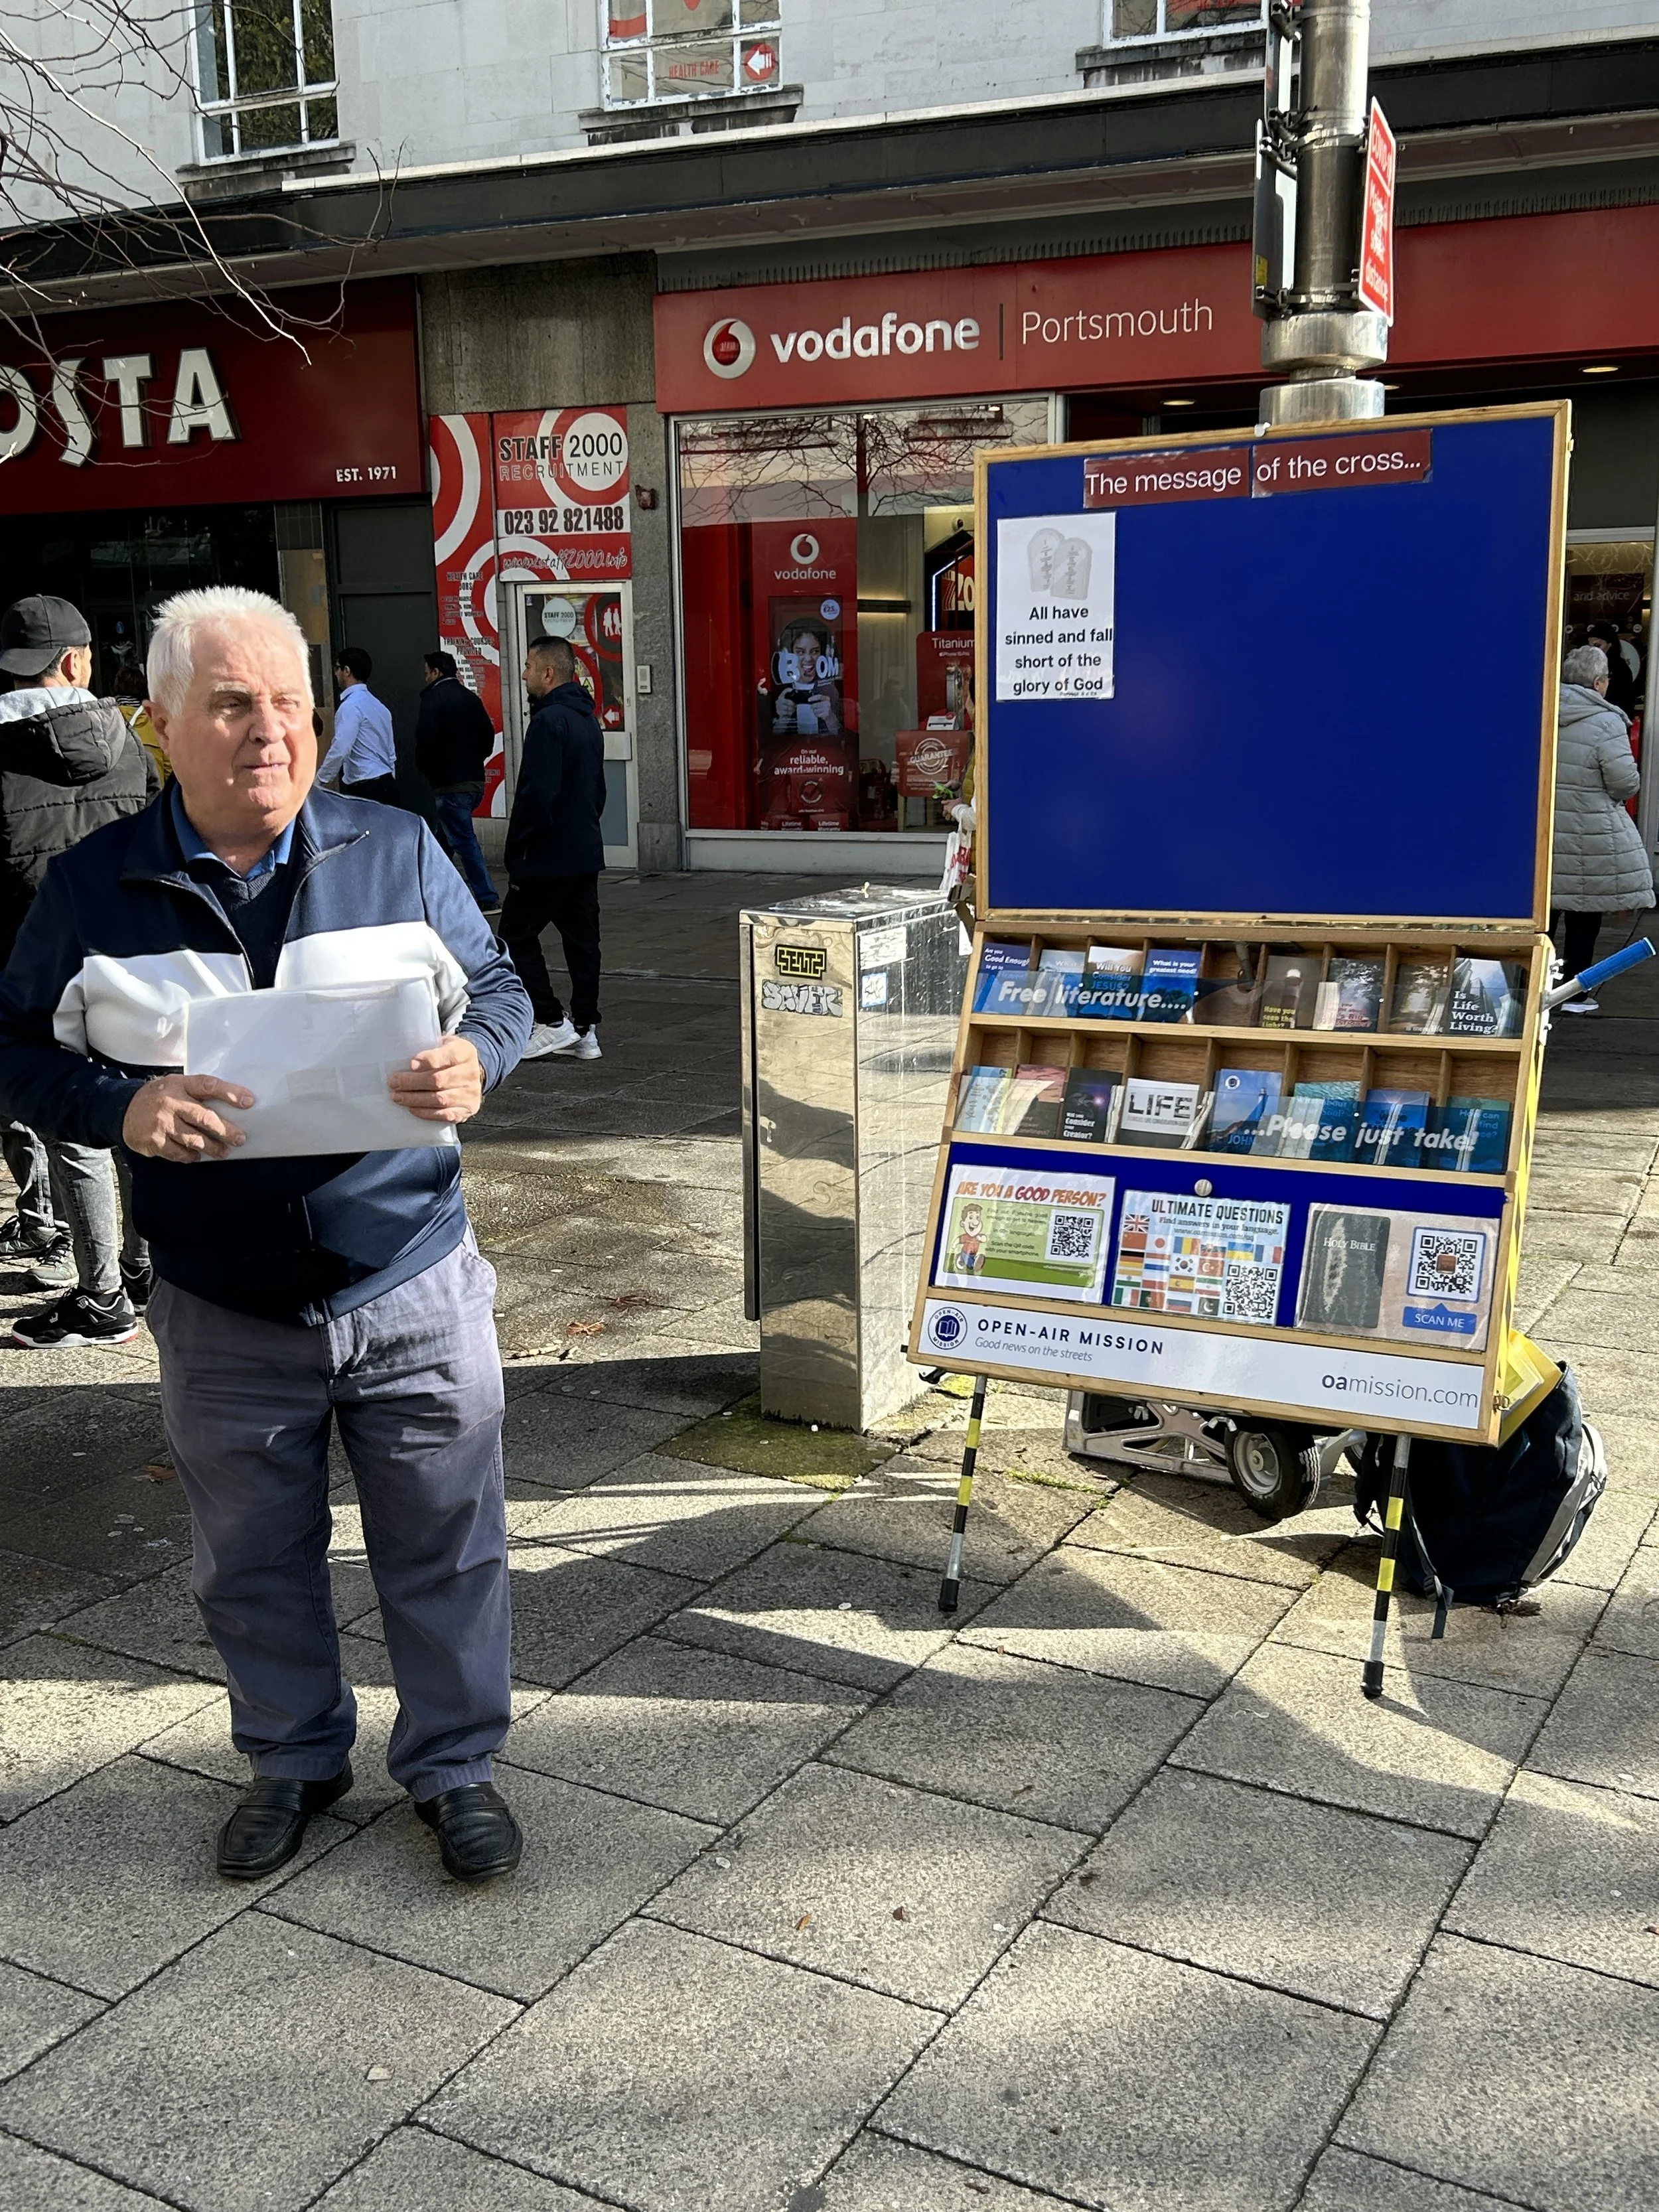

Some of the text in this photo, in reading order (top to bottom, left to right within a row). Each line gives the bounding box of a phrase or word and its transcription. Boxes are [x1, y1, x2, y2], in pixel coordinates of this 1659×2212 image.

[1023, 298, 1212, 344] Portsmouth
[770, 312, 980, 363] vodafone
[499, 433, 622, 463] STAFF 2000
[336, 467, 397, 482] EST. 1971
[500, 461, 623, 481] RECRUITMENT
[1085, 451, 1420, 495] The message of the cross...
[504, 506, 624, 535] 023 92 821488
[504, 548, 627, 570] www.staff2000.info
[774, 568, 836, 581] vodafone
[1029, 606, 1089, 621] All have
[1005, 628, 1113, 645] sinned and fall
[1015, 653, 1102, 669] short of the
[1013, 676, 1103, 696] glory of God
[790, 755, 828, 765] reliable,
[774, 765, 844, 776] award-winning
[984, 954, 1003, 963] Good
[1096, 962, 1132, 973] Will You
[1092, 972, 1131, 981] Consider
[997, 981, 1047, 1003] Free
[1455, 991, 1467, 999] Is
[1264, 1005, 1281, 1014] Have
[1453, 1001, 1479, 1011] Life
[1452, 1011, 1494, 1023] Worth
[1449, 1022, 1498, 1035] Living?
[1128, 1092, 1193, 1119] LIFE
[1065, 1117, 1095, 1128] Consider
[1063, 1130, 1093, 1140] Creator?
[1355, 1122, 1405, 1148] just
[1414, 1128, 1479, 1151] take!
[956, 1181, 1108, 1207] ARE YOU A GOOD PERSON?
[1152, 1199, 1284, 1224] ULTIMATE QUESTIONS
[1159, 1217, 1177, 1225] Find
[1178, 1218, 1210, 1228] answers
[1323, 1237, 1376, 1251] HOLY BIBLE
[934, 1309, 964, 1323] OPEN-AIR
[1414, 1313, 1465, 1328] SCAN ME
[932, 1336, 960, 1348] MISSION
[977, 1319, 1163, 1355] OPEN-AIR MISSION
[975, 1336, 1093, 1362] Good news on the streets
[1321, 1374, 1479, 1408] oamission.com
